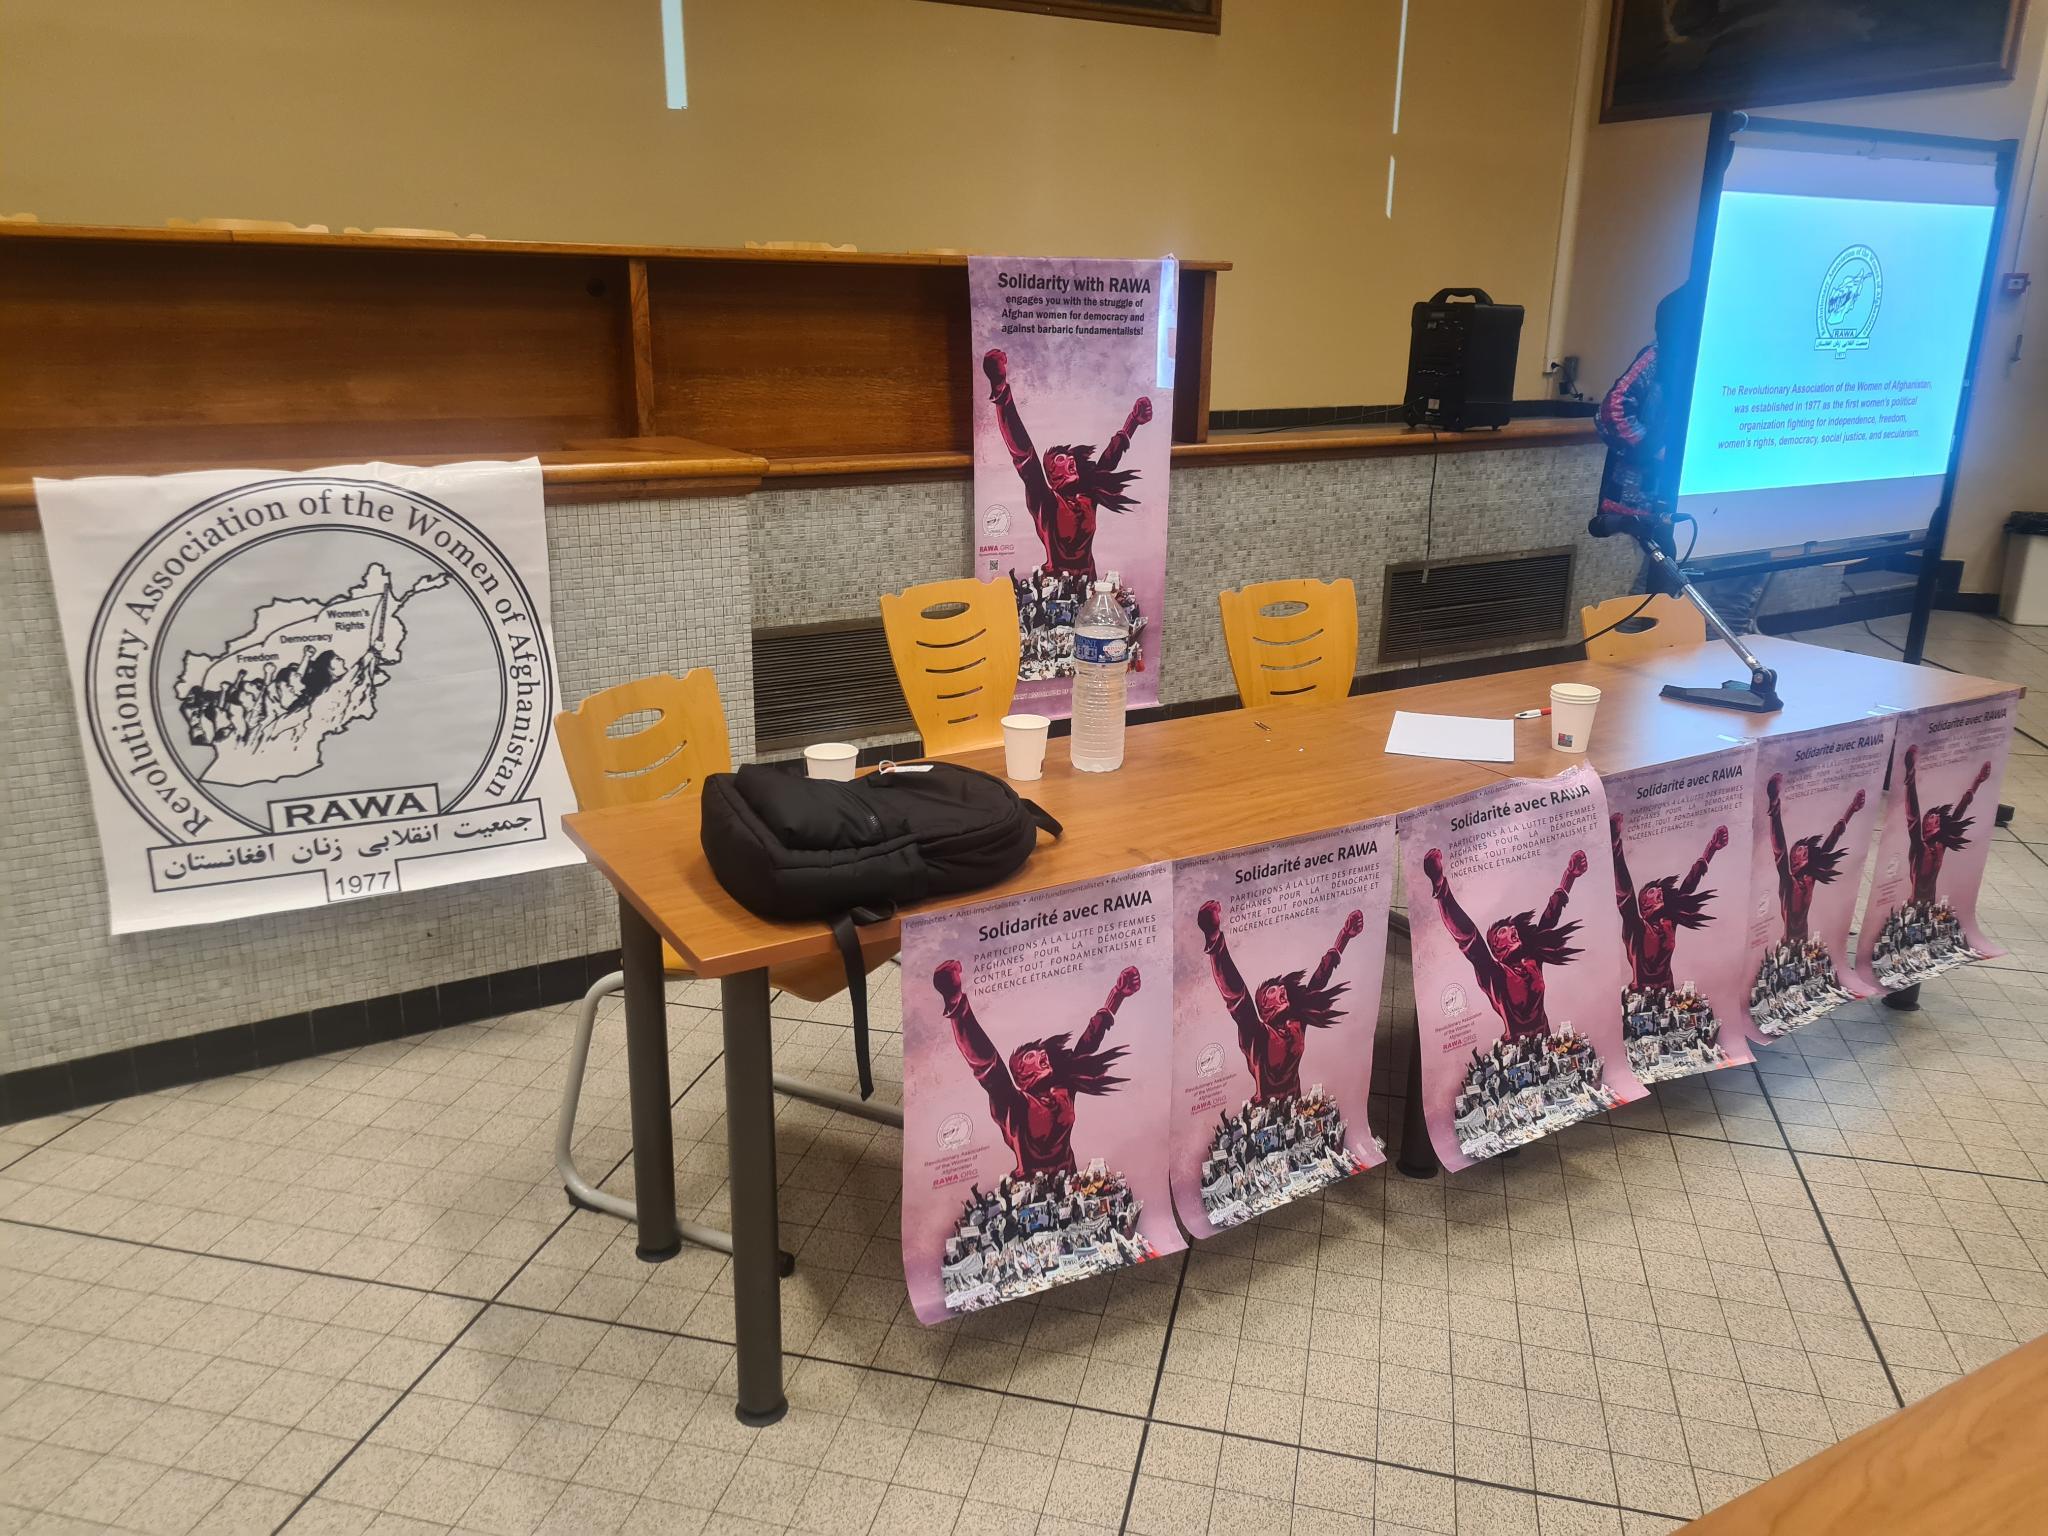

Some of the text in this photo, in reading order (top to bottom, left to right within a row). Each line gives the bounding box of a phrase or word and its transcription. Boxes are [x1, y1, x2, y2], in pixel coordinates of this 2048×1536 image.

[998, 272, 1151, 293] Solidarity with RAWA
[1002, 308, 1144, 323] Afghan women for democracy and
[1006, 295, 1143, 309] engages you with the struggle of
[1001, 325, 1035, 335] against
[1038, 325, 1073, 334] barbaric
[1722, 386, 1736, 395] The
[1738, 385, 1790, 396] Revolutionary
[1792, 383, 1834, 393] Association
[1836, 383, 1843, 392] of
[1845, 383, 1855, 391] the
[1884, 381, 1891, 390] of
[1734, 396, 1918, 413] was established in 1977 as the first women's political
[1739, 419, 1785, 432] organization
[1787, 418, 1814, 430] fighting
[1817, 417, 1826, 426] for
[1718, 438, 1751, 449] women's
[1754, 437, 1776, 449] rights,
[1821, 434, 1842, 443] social
[1869, 431, 1882, 440] and
[327, 609, 369, 618] Women's
[335, 620, 365, 631] Rights
[280, 633, 333, 644] Democracy
[112, 490, 540, 836] Revolutionary Association of the Women of Afghanistan
[237, 653, 279, 663] Freedom
[1928, 708, 2006, 734] Solidarité avec RAWA
[1794, 734, 1884, 762] Solidarité avec RAWA
[1636, 778, 1685, 799] Solidarité
[1687, 775, 1709, 788] avec
[1712, 765, 1742, 782] RAWA
[284, 793, 428, 826] RAWA
[1451, 805, 1510, 832] Solidarité
[1514, 797, 1547, 814] avec
[1550, 785, 1590, 805] RAWA
[1449, 830, 1497, 849] PARTICIPONS
[1507, 825, 1519, 833] LA
[1522, 818, 1547, 830] LUTTE
[1549, 814, 1563, 822] DES
[1566, 804, 1596, 818] FEMMES
[1450, 842, 1488, 859] AFGHANES
[1495, 835, 1519, 846] POUR
[1550, 813, 1597, 832] DÉMOCRATIE
[164, 812, 533, 879] جمعیت انقلابی زنان افغانستان
[1450, 822, 1598, 869] CONTRE TOUT FONDAMENTALISME ET
[1235, 859, 1301, 884] Solidarité
[1304, 852, 1334, 868] avec
[1338, 841, 1378, 861] RAWA
[335, 870, 392, 895] 1977
[1230, 885, 1283, 903] PARTICIPONS
[1294, 880, 1303, 888] LA
[1306, 874, 1330, 886] LUTTE
[1332, 871, 1346, 879] DES
[1348, 863, 1380, 876] FEMMES
[1230, 898, 1272, 914] AFGHANES
[1279, 891, 1301, 900] POUR
[1332, 872, 1380, 889] DÉMOCRATIE
[979, 890, 1152, 942] Solidarité avec RAWA
[1230, 882, 1379, 923] CONTRE TOUT FONDAMENTALISME ET
[974, 941, 1038, 962] PARTICIPONS
[1051, 934, 1063, 943] LA
[1066, 928, 1094, 941] LUTTE
[1097, 923, 1115, 934] DES
[1118, 915, 1156, 929] FEMMES
[974, 925, 1156, 974] AFGHANES POUR LA DÉMOCRATIE
[974, 936, 1156, 985] CONTRE TOUT FONDAMENTALISME ET
[974, 978, 1027, 996] INGÉRENCE
